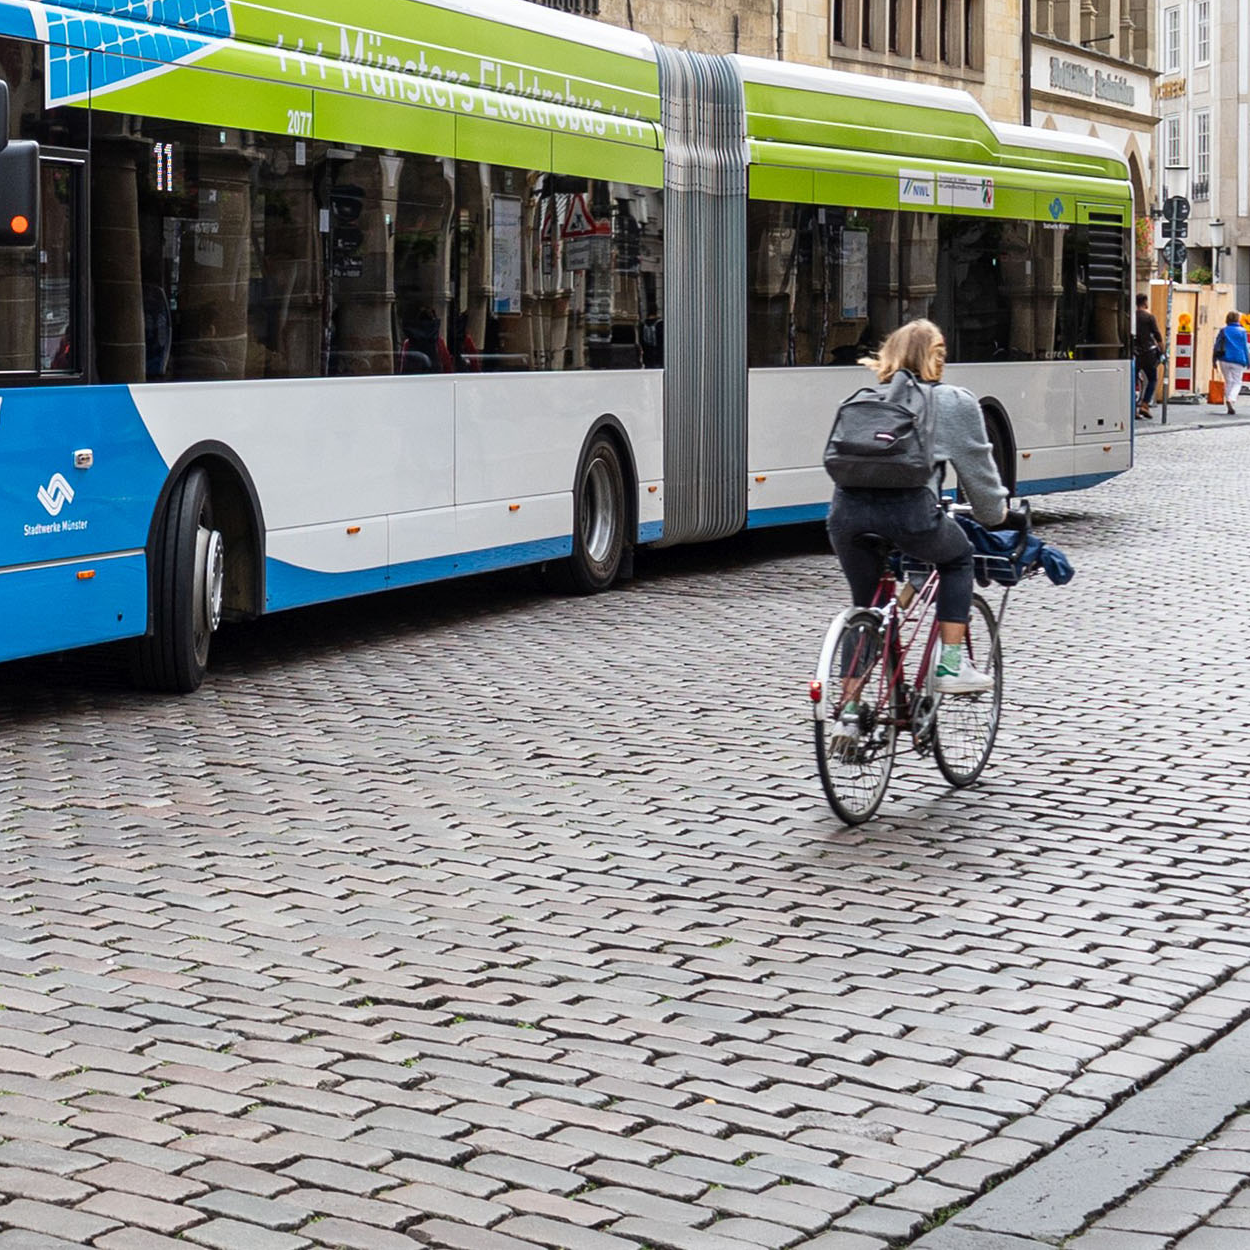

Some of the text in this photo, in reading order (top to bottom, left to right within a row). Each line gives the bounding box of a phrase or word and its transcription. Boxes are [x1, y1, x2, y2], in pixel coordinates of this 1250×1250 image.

[340, 27, 606, 135] Münsters Elektrobus
[287, 109, 313, 136] 2077
[154, 142, 173, 192] 11
[24, 519, 88, 536] Stadtwerke Münster
